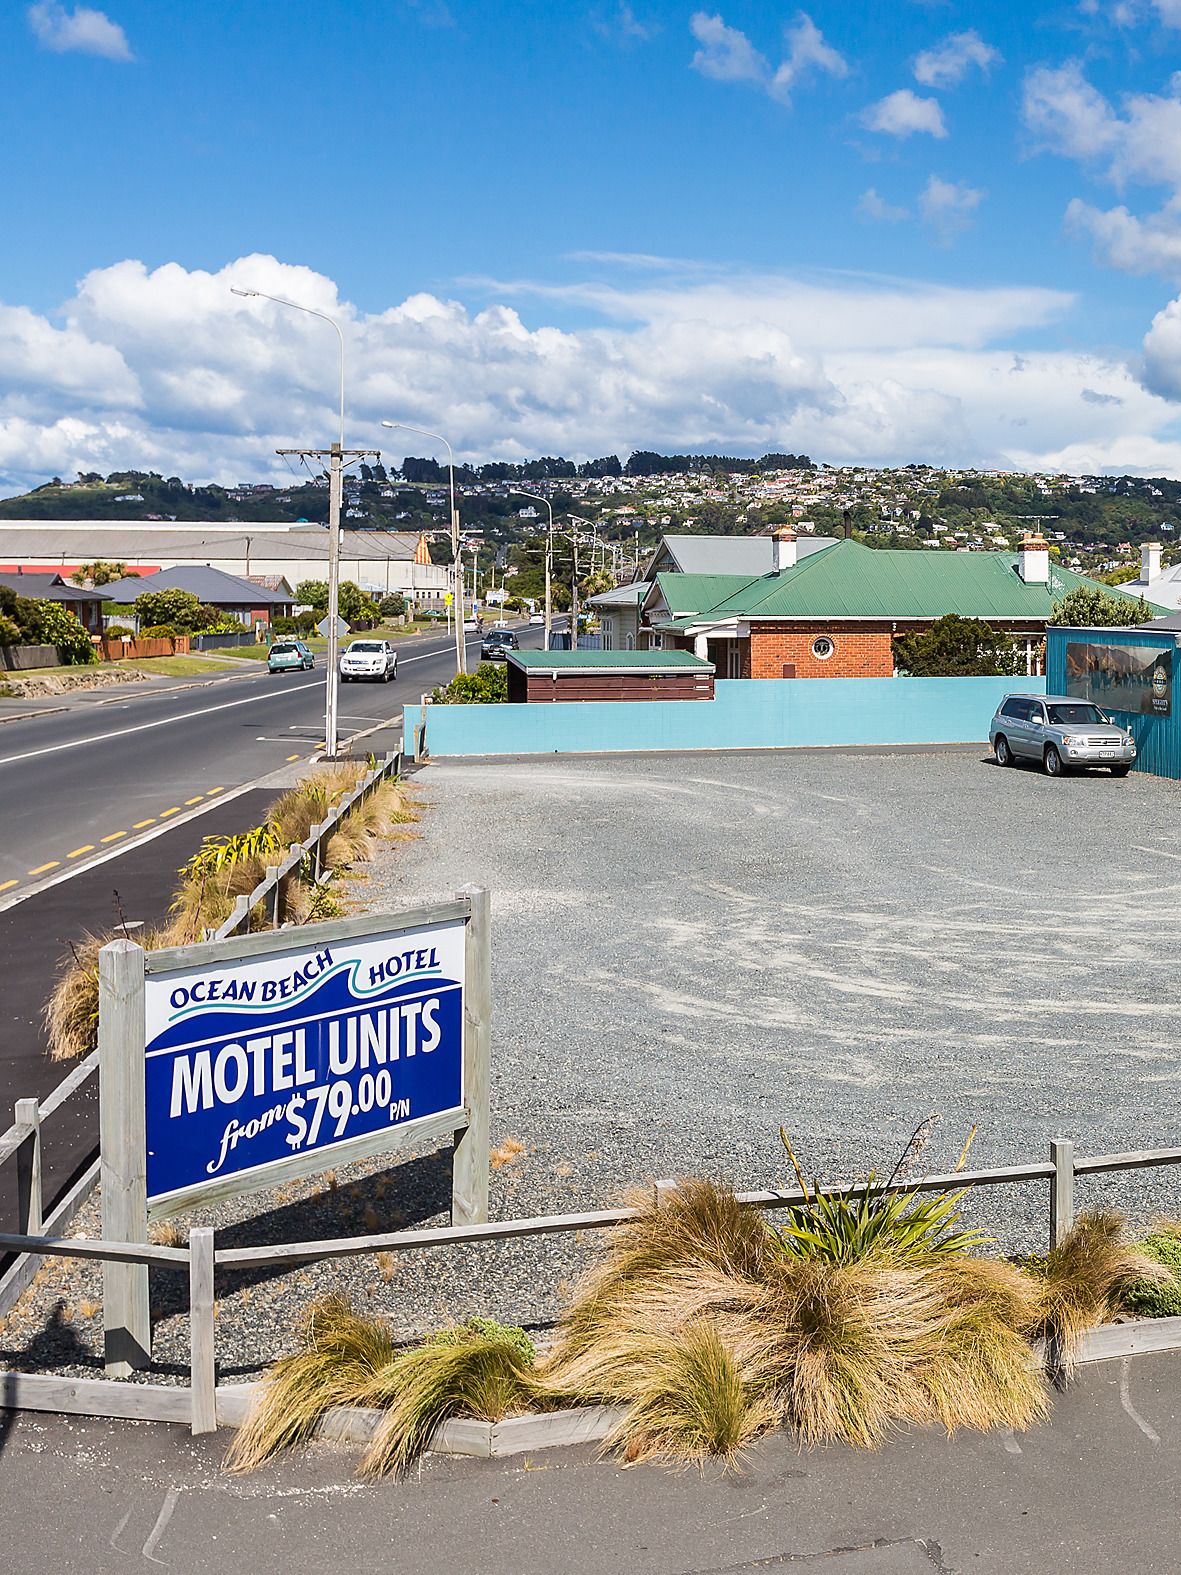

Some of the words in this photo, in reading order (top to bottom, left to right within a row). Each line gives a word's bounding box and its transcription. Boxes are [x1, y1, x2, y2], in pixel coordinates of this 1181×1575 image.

[170, 980, 257, 1009] OCEAN
[261, 948, 333, 1001] BEACH
[368, 948, 440, 986] HOTEL
[170, 1029, 316, 1118] MOTEL
[328, 998, 442, 1075] UNITS
[206, 1103, 287, 1174] from
[285, 1069, 392, 1150] $79.00
[389, 1098, 410, 1121] P/N
